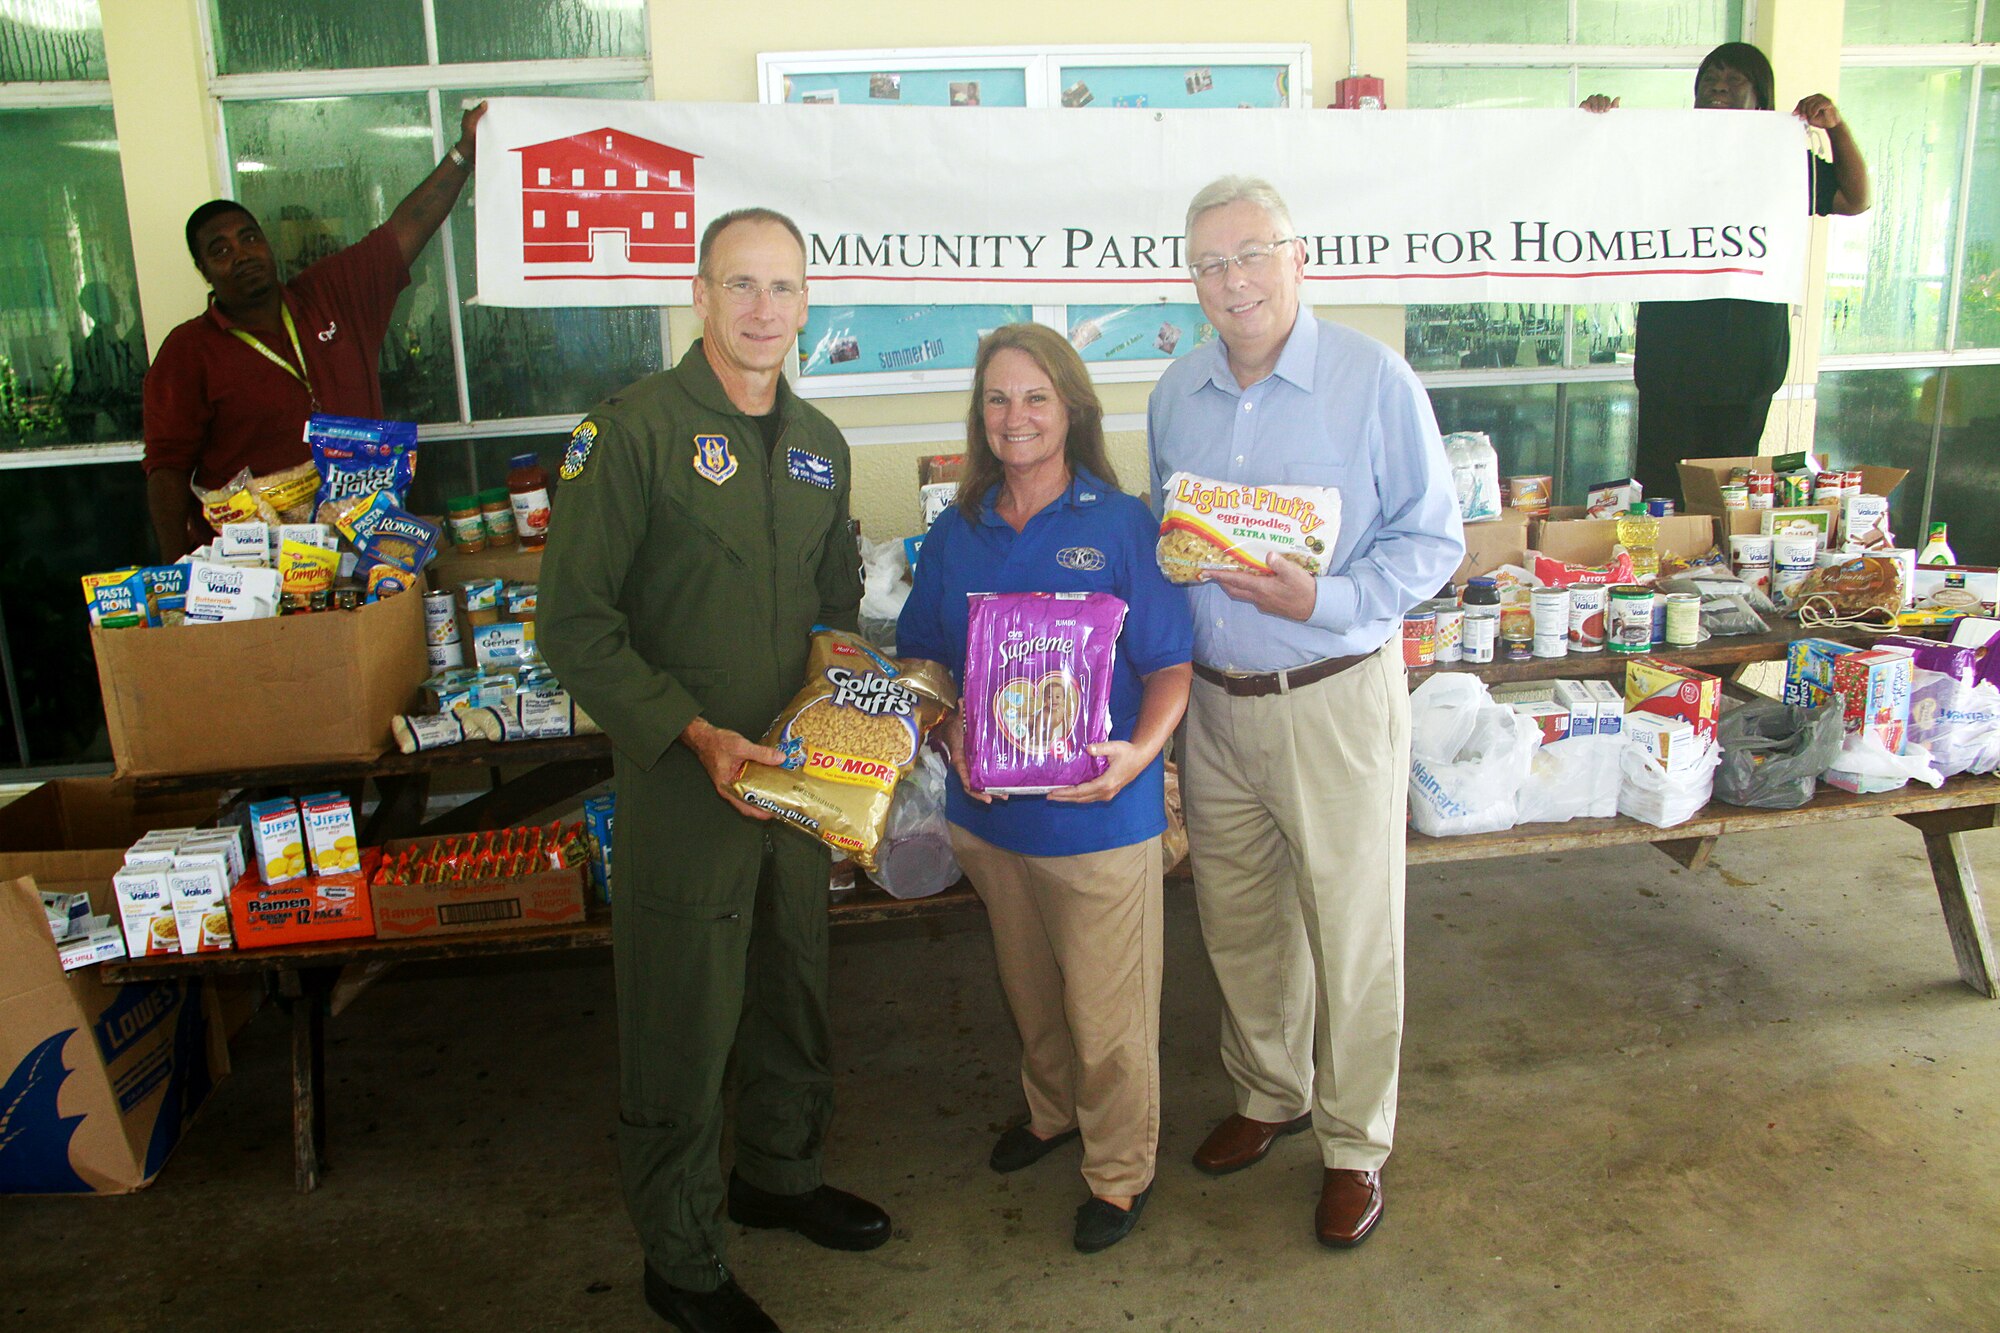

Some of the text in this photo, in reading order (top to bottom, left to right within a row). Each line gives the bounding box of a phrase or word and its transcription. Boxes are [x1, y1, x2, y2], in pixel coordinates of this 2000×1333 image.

[808, 232, 1047, 269] MMUNITY
[1403, 229, 1497, 265] FOR
[1509, 221, 1768, 264] HOMELESS
[923, 338, 945, 361] Fun
[329, 475, 394, 500] Flakes
[1175, 479, 1240, 515] Light
[1253, 487, 1324, 534] Fluffy
[354, 508, 385, 534] PASTA
[1216, 512, 1292, 534] egg noodles
[226, 526, 264, 541] Great
[379, 517, 431, 542] RONZONI
[1232, 527, 1296, 546] EXTRA WIDE
[236, 536, 264, 545] Value
[1750, 554, 1769, 562] Value
[1791, 554, 1812, 563] Value
[150, 569, 183, 584] ASTA
[197, 567, 243, 586] Great
[1579, 574, 1607, 583] Arroz
[96, 586, 132, 600] PASTA
[153, 580, 180, 595] ONI
[208, 583, 241, 595] Value
[101, 599, 132, 612] RONI
[1574, 602, 1599, 610] Value
[1055, 619, 1076, 628] JUMBO
[1007, 630, 1023, 638] CVS
[482, 638, 520, 650] Gerber
[998, 636, 1075, 669] Supreme
[826, 667, 919, 704] Golden
[833, 686, 912, 716] Puffs
[809, 752, 842, 769] 50%
[842, 759, 896, 784] MORE
[1411, 759, 1460, 817] Walmart
[743, 792, 785, 815] Golden
[787, 809, 820, 830] Puffs
[312, 813, 350, 827] JIFFY
[839, 836, 864, 849] MORE
[171, 875, 211, 891] Great
[129, 891, 160, 901] Value
[182, 887, 213, 898] Value
[248, 897, 311, 914] Ramen
[379, 906, 436, 920] Ramen
[296, 909, 312, 925] 12
[314, 908, 344, 918] PACK
